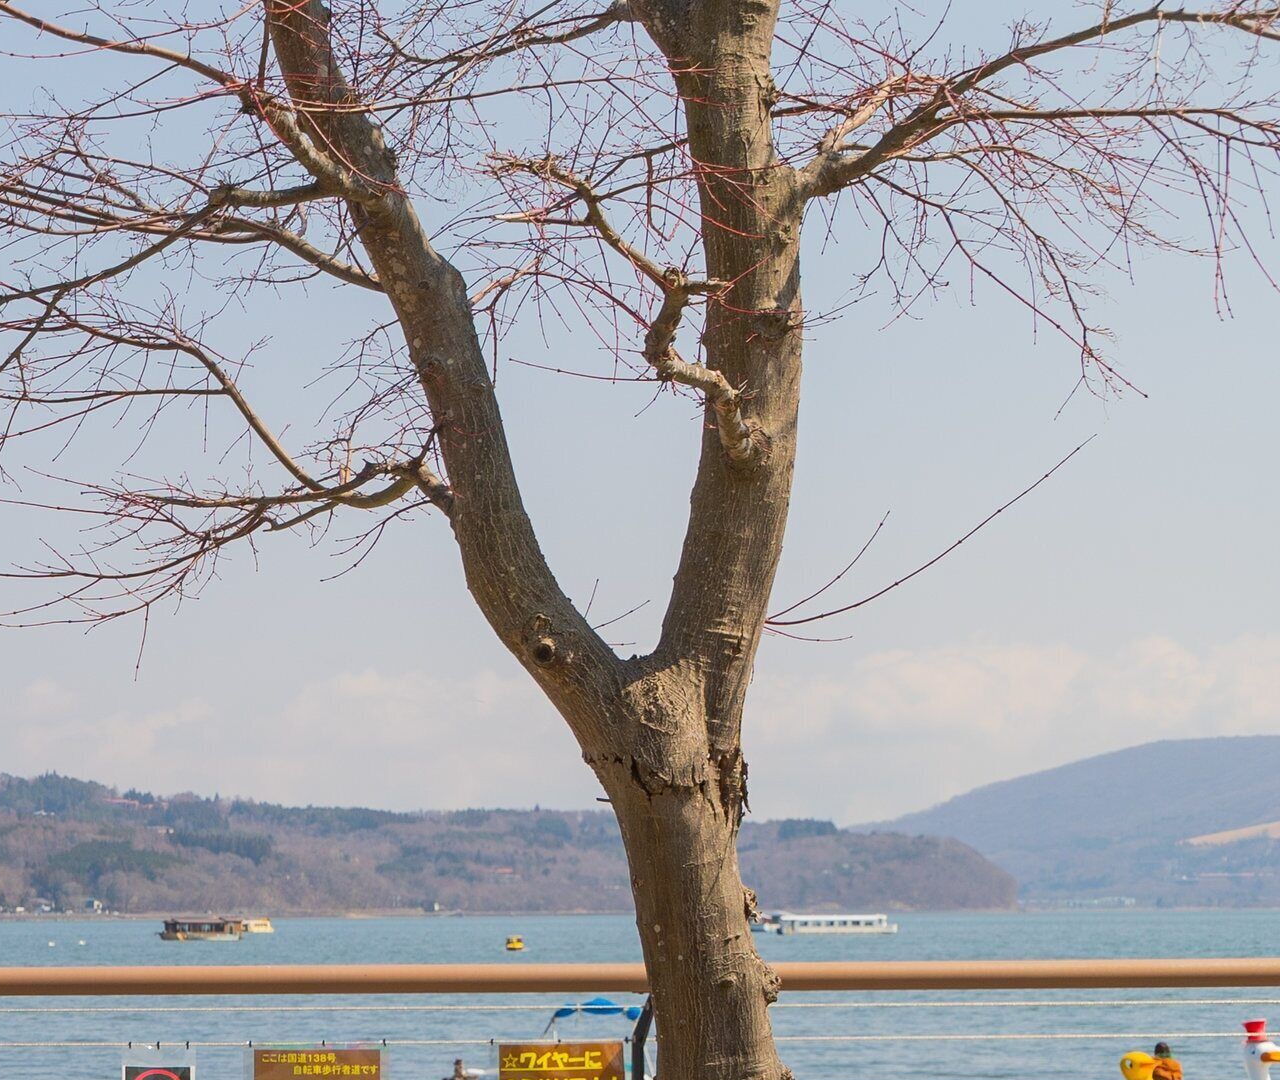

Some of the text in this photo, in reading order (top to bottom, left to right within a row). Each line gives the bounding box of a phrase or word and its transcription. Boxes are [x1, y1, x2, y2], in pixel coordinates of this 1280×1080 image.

[261, 1053, 337, 1064] ここは国道138号
[519, 1051, 602, 1069] ワイヤーに
[293, 1064, 379, 1076] 自転車歩行者道です
